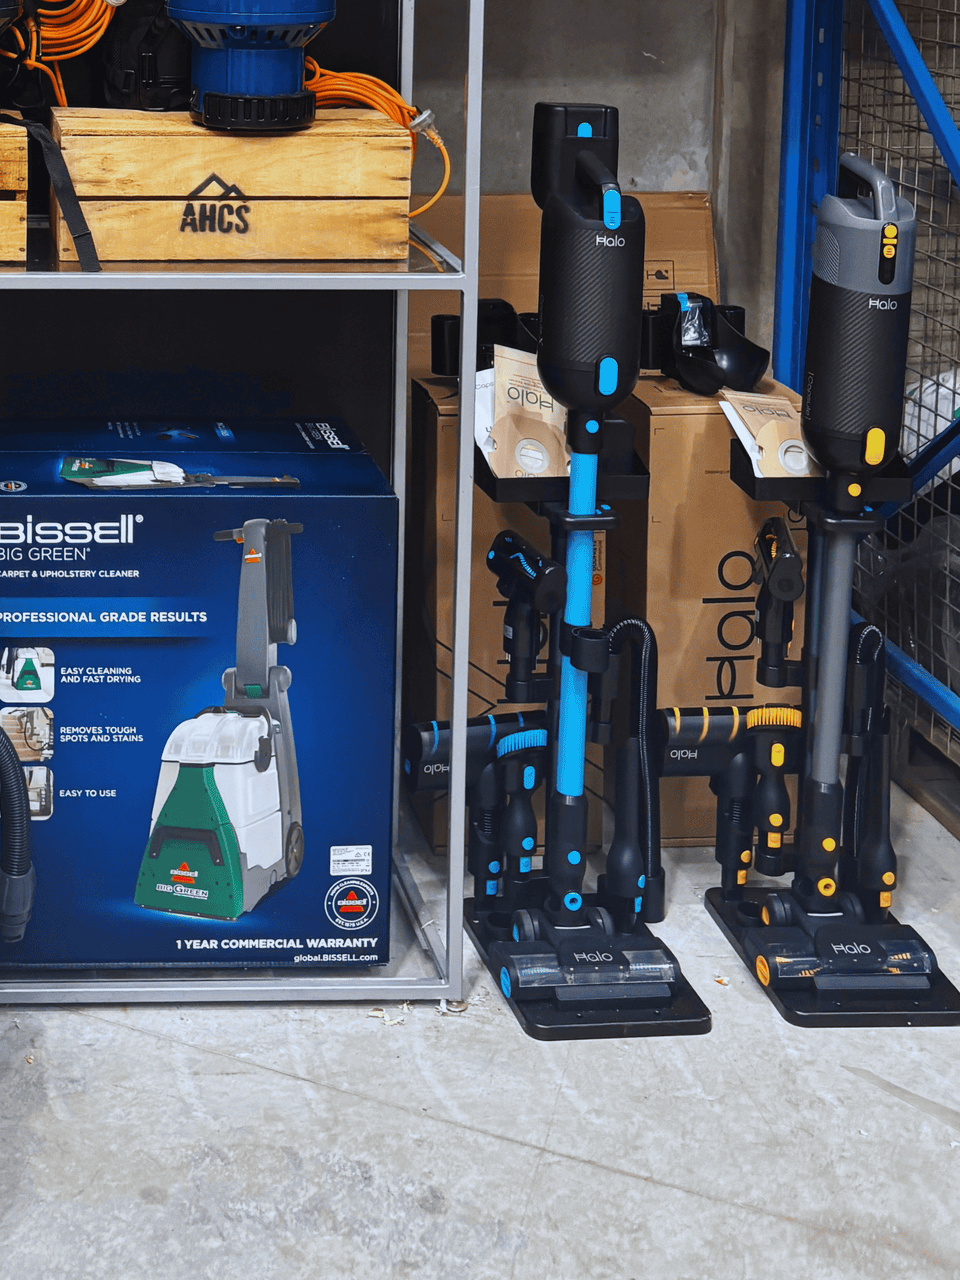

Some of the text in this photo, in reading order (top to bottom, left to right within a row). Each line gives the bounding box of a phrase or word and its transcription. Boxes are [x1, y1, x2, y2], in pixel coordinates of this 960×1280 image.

[180, 203, 251, 234] AHCS
[595, 235, 626, 247] Halo
[868, 298, 898, 310] Halo
[28, 548, 86, 561] GREEN
[31, 570, 38, 578] &
[40, 570, 96, 578] UPHOLSTERY
[98, 570, 140, 578] CLEANER
[99, 612, 147, 623] GRADE
[150, 612, 208, 623] RESULTS
[60, 667, 133, 675] EASY CLEANING
[60, 675, 142, 683] AND FAST DRYING
[59, 726, 137, 734] REMOVES TOUGH
[59, 734, 144, 742] SPOTS AND STAINS
[670, 749, 697, 760] Halo
[59, 789, 117, 797] EASY TO USE
[156, 883, 173, 893] BIG
[176, 938, 378, 949] 1 YEAR COMMERCIAL WARRANTY
[831, 943, 871, 954] Halo
[294, 954, 378, 963] global.BISSELL.com
[574, 951, 613, 962] Halo
